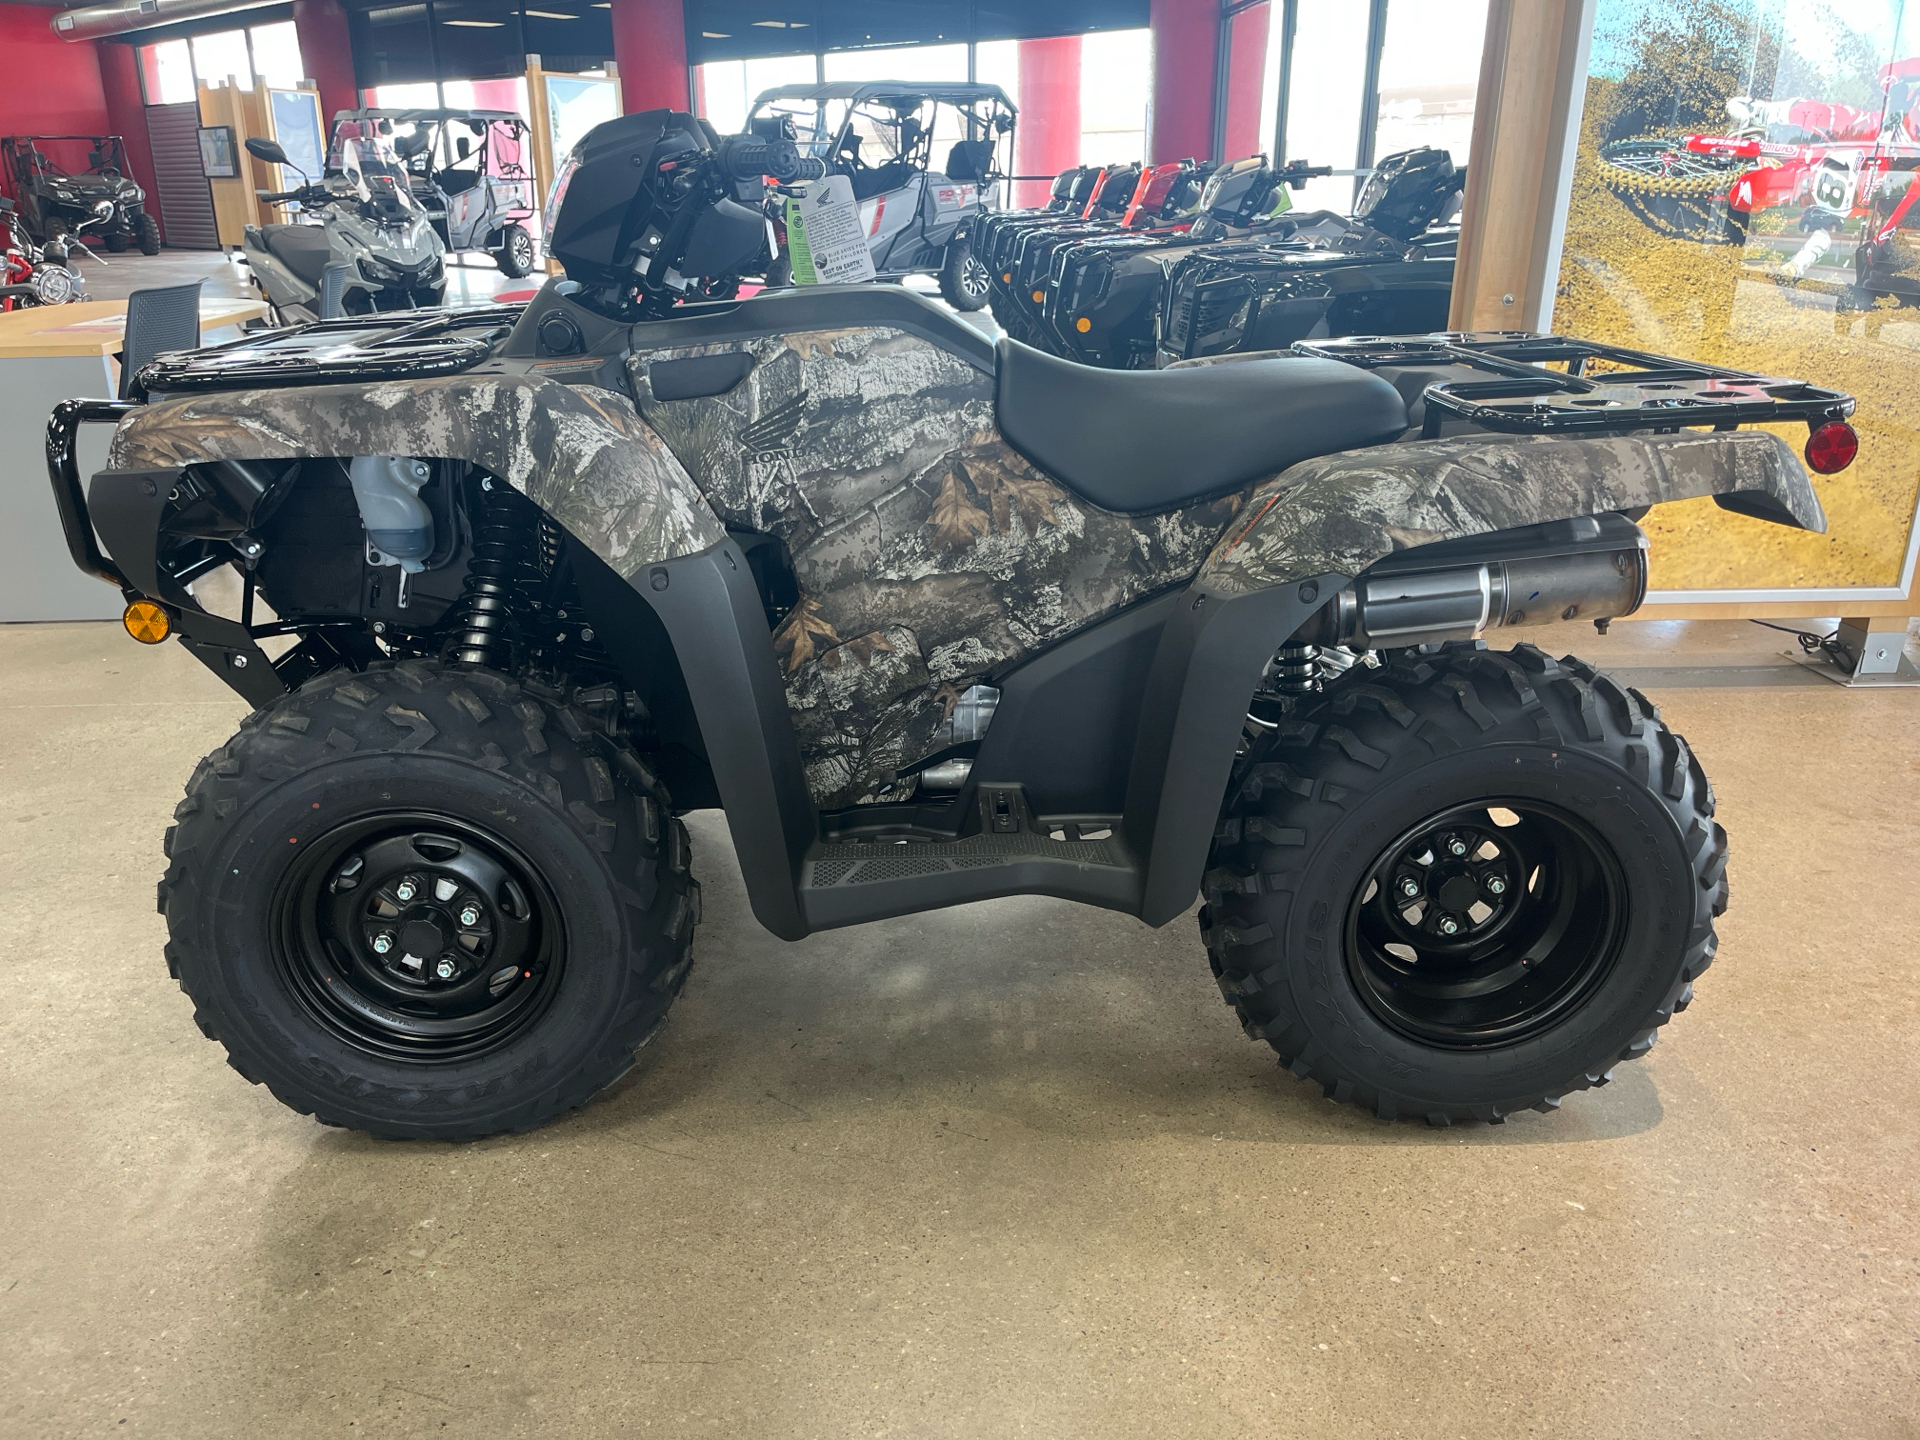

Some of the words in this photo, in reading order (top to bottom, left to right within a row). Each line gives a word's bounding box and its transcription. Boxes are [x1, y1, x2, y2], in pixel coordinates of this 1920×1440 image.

[1700, 137, 1749, 147] DUNLOP
[823, 268, 835, 276] BEST
[742, 446, 823, 466] HONDA
[1304, 899, 1431, 1083] MAXXIS
[305, 1053, 549, 1105] MAXXIS
